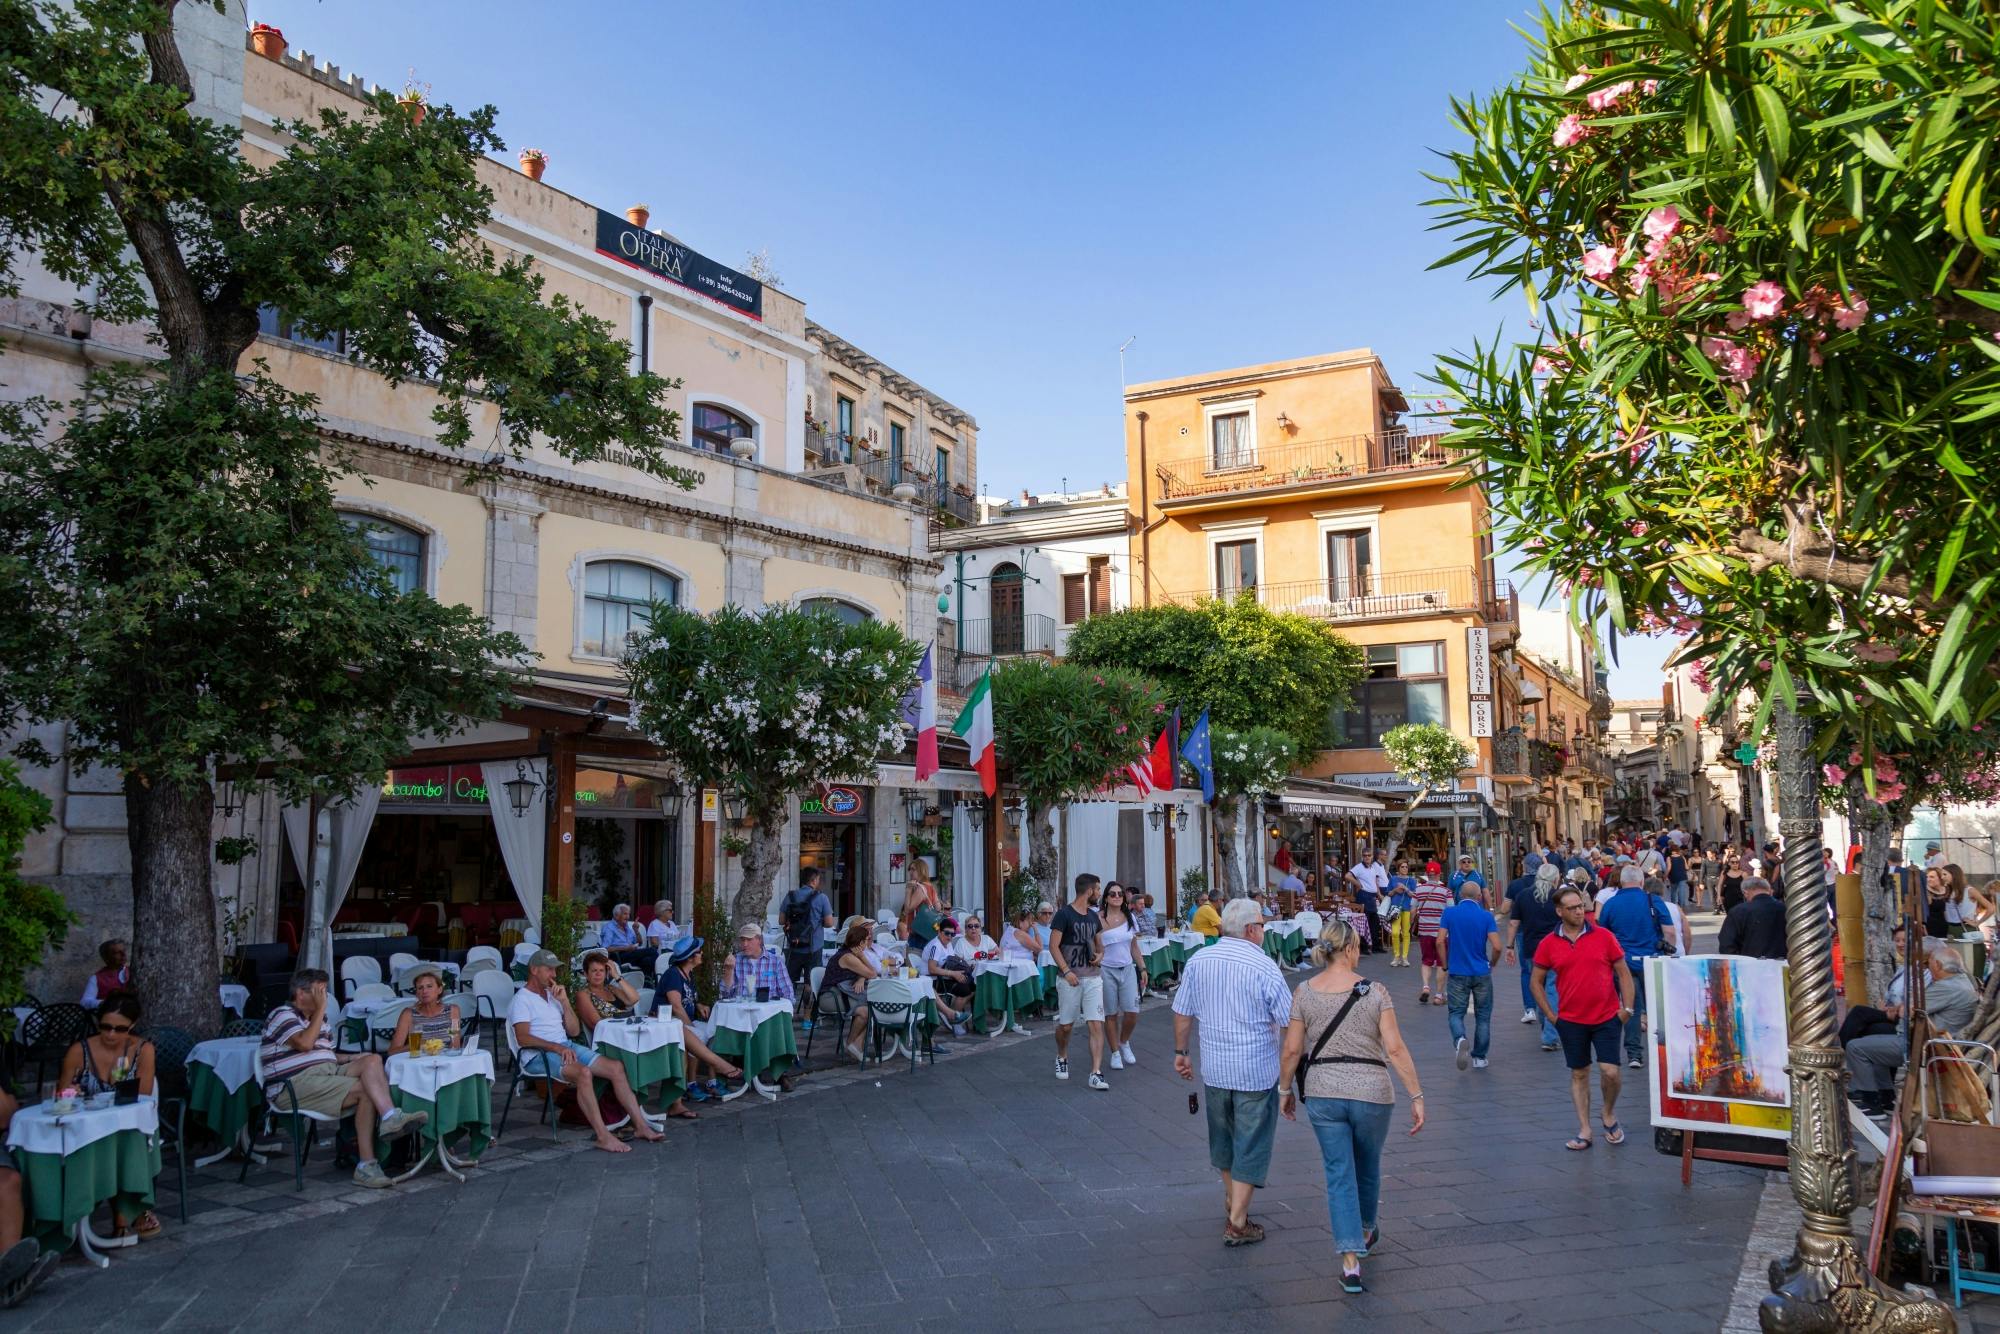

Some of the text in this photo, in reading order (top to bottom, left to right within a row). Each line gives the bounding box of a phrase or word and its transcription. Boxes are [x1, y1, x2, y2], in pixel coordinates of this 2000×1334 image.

[638, 230, 683, 258] ITALIAN
[620, 231, 682, 278] OPERA
[698, 273, 716, 288] (+39)
[720, 274, 732, 285] Info
[674, 465, 706, 485] OSCO
[1473, 629, 1484, 693] RISTORANTE
[1476, 703, 1486, 735] CORSO
[382, 779, 443, 797] ocambo
[1424, 794, 1468, 803] ASTICCERIA
[1324, 806, 1332, 814] NO
[1332, 806, 1344, 815] STOP
[1346, 808, 1371, 816] RISTORANTE
[1372, 809, 1381, 817] BAR
